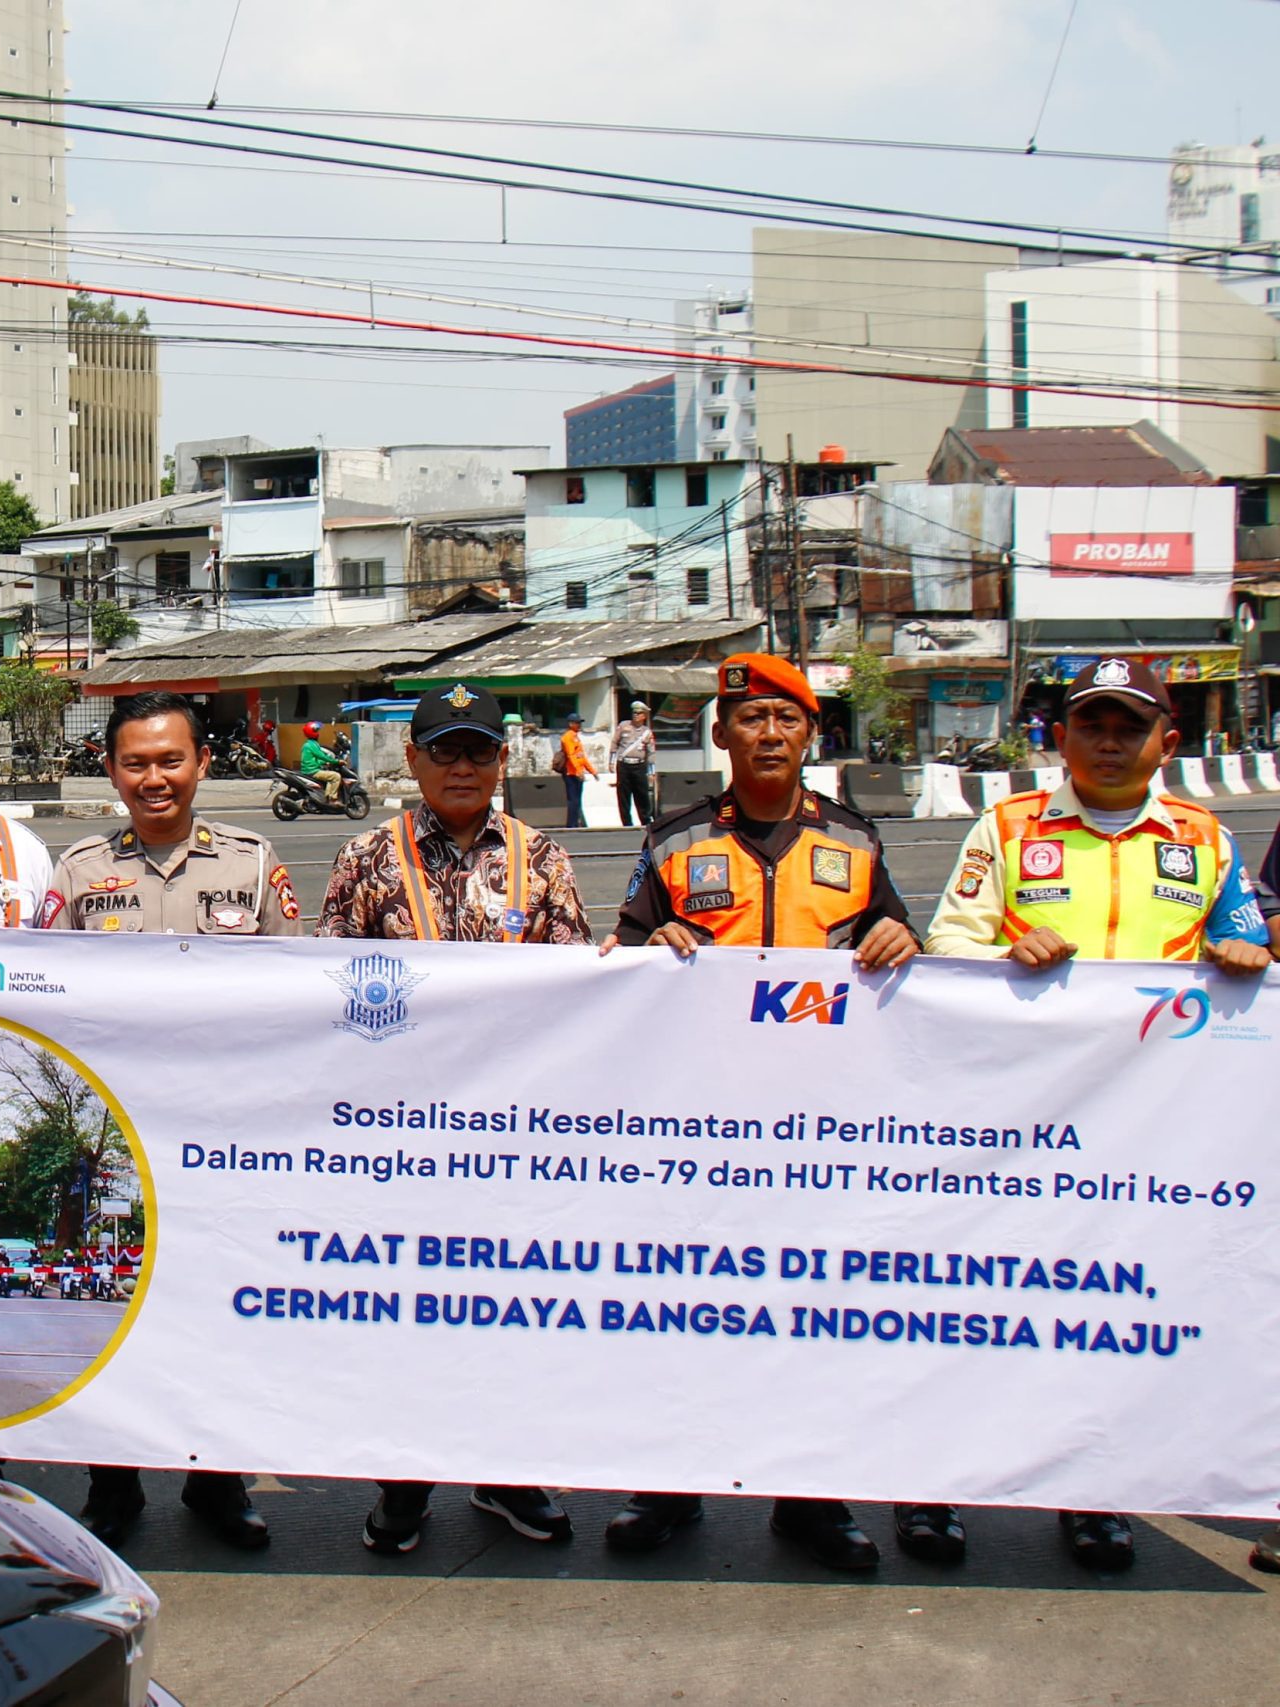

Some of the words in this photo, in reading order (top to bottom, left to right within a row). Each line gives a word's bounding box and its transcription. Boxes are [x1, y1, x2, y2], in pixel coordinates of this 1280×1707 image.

[1073, 543, 1170, 560] PROBAN
[691, 864, 726, 882] KAI
[198, 890, 254, 906] POLRI
[685, 893, 729, 911] RIYADI
[1023, 888, 1061, 898] TEGUH
[1157, 887, 1202, 905] SATPAM
[85, 895, 141, 912] PRIMA
[9, 972, 46, 982] UNTUK
[8, 983, 66, 993] INDONESIA
[751, 981, 849, 1024] KAI
[1134, 987, 1210, 1042] 79
[332, 1100, 518, 1133] Sosialisasi
[528, 1108, 763, 1140] Keselamatan
[773, 1112, 806, 1141] di
[816, 1115, 1022, 1149] Perlintasan
[1032, 1124, 1082, 1151] KA
[182, 1143, 293, 1172] Dalam
[304, 1148, 436, 1183] Rangka
[448, 1153, 520, 1180] HUT
[530, 1155, 588, 1182] KAI
[599, 1156, 698, 1185] ke-79
[707, 1160, 774, 1188] dan
[785, 1163, 858, 1190] HUT
[867, 1165, 1043, 1198] Korlantas
[1054, 1173, 1137, 1202] Polri
[1148, 1175, 1256, 1208] ke-69
[417, 1235, 600, 1273] BERLALU
[614, 1242, 766, 1279] LINTAS
[780, 1248, 828, 1281] DI
[841, 1250, 1157, 1300] PERLINTASAN,
[232, 1286, 400, 1323] CERMIN
[414, 1293, 587, 1330] BUDAYA
[600, 1300, 777, 1337] BANGSA
[790, 1306, 1041, 1349] INDONESIA
